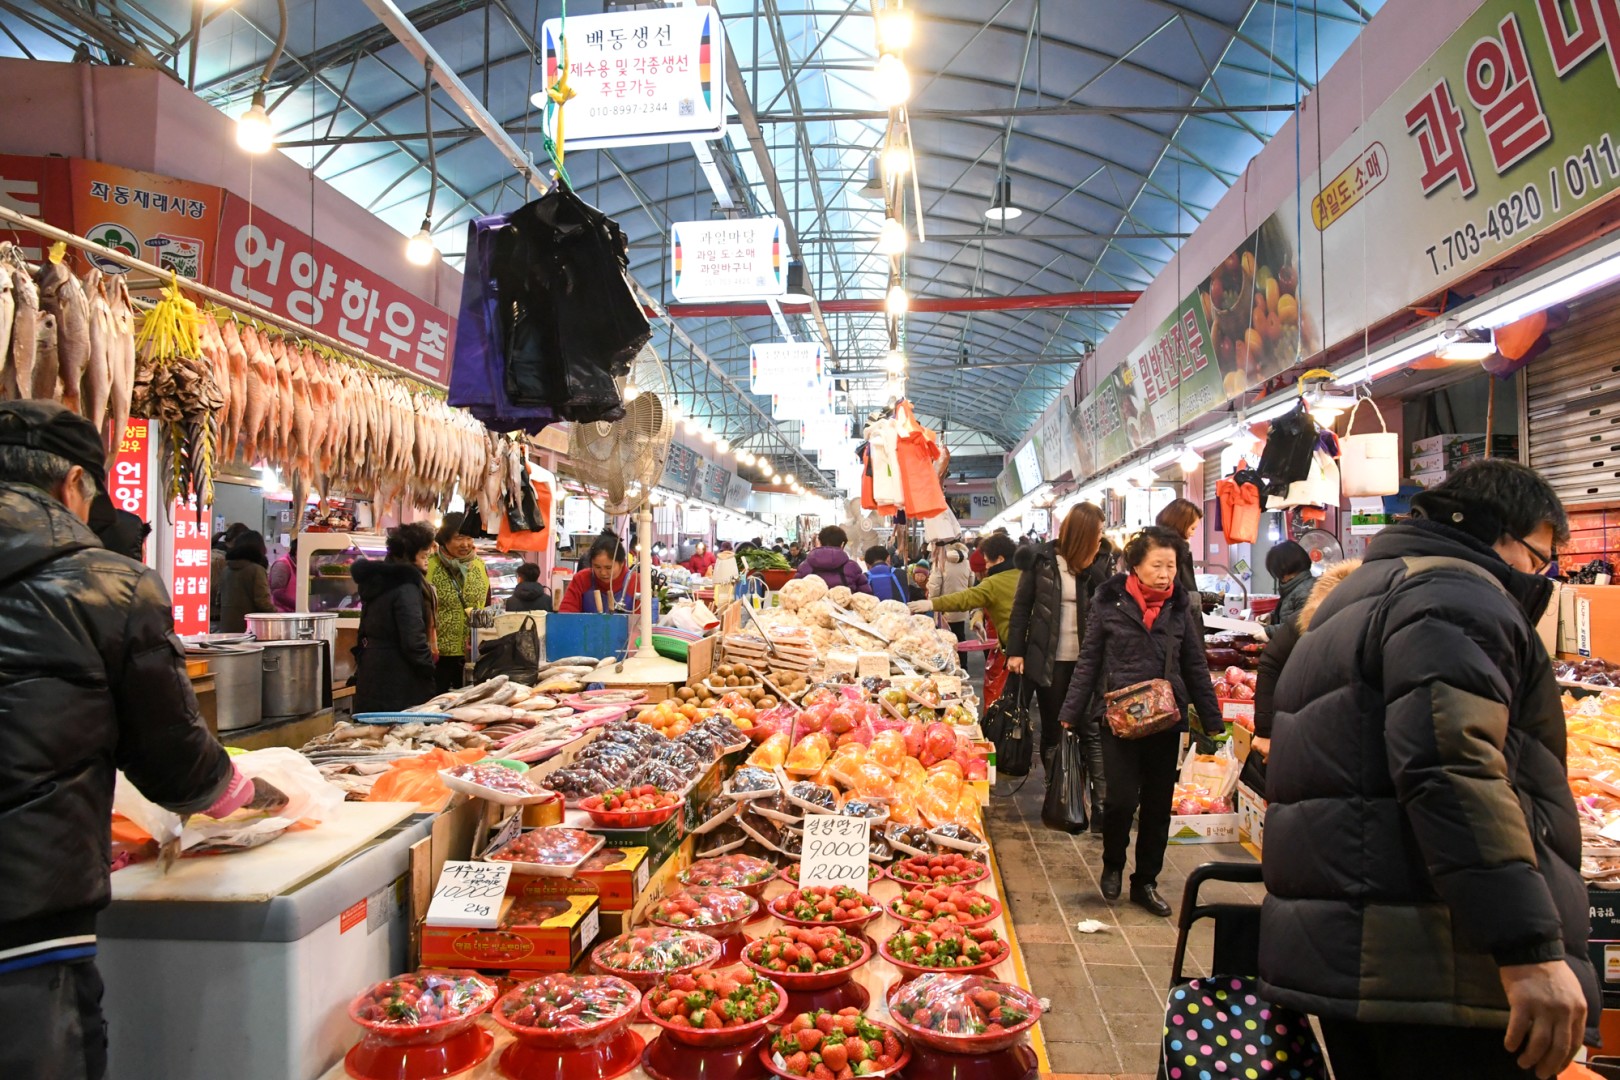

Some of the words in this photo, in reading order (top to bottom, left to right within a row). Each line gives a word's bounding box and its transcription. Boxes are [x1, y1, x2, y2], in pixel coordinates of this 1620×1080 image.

[586, 24, 673, 51] 백동생선
[570, 60, 610, 79] 제수용
[616, 58, 628, 76] 및
[633, 55, 689, 76] 각종생선
[600, 79, 657, 98] 주문가능
[589, 102, 669, 118] 010-8997-2344
[91, 181, 206, 218] 좌동재래시장
[701, 229, 756, 245] 과일마당
[1425, 186, 1542, 275] T.703-4820
[695, 249, 717, 261] 과일
[700, 262, 753, 275] 과일바구니
[230, 224, 448, 378] 언양한우촌
[125, 425, 147, 438] 상급
[175, 577, 208, 595] 삼겹살
[463, 903, 491, 916] 2kg
